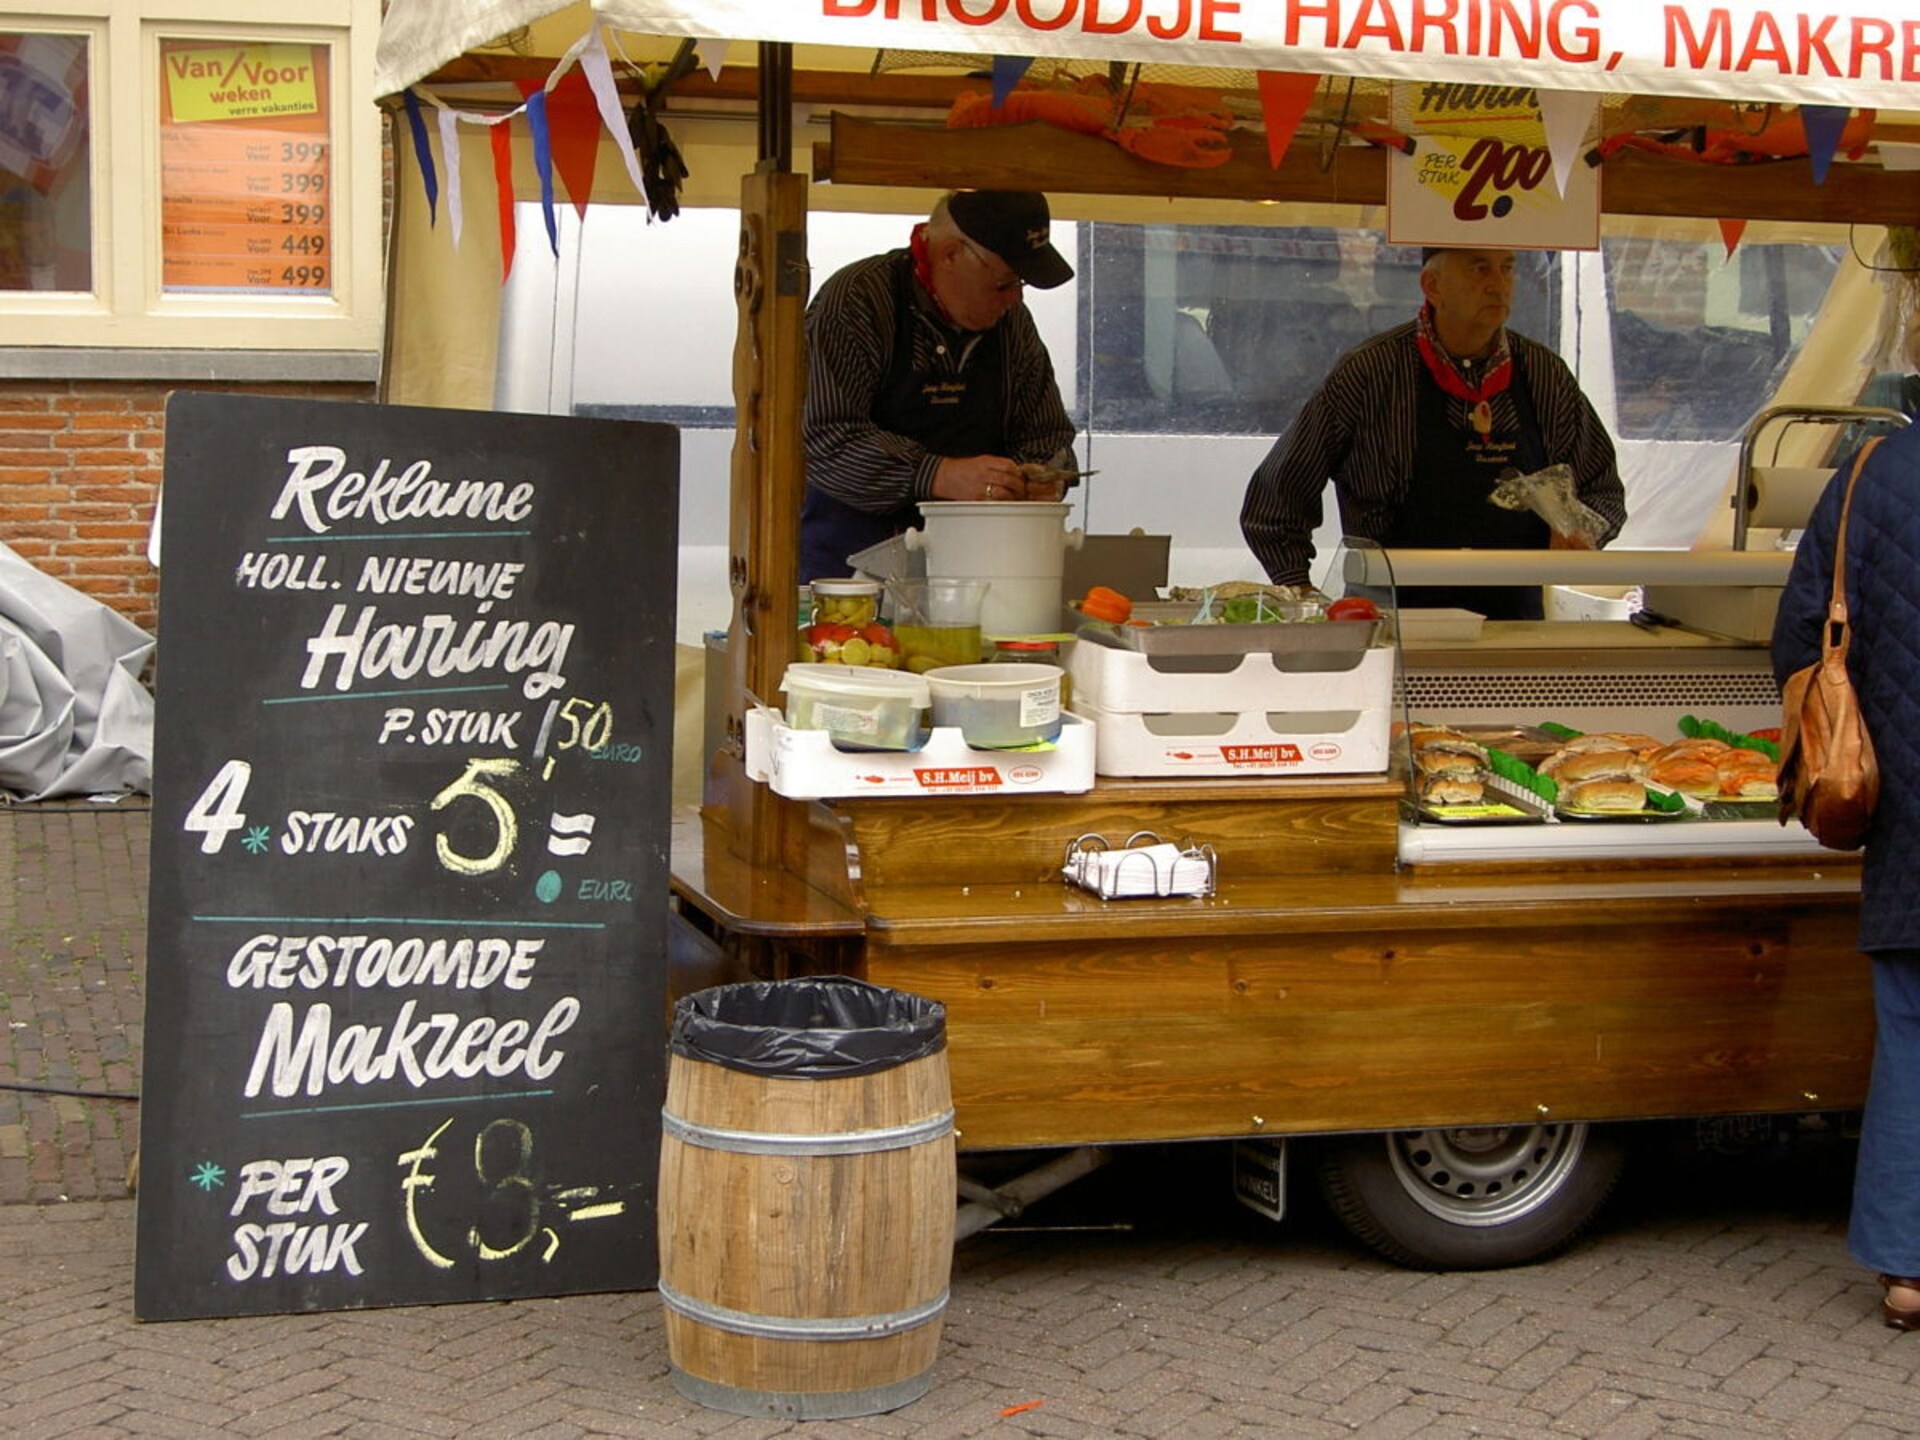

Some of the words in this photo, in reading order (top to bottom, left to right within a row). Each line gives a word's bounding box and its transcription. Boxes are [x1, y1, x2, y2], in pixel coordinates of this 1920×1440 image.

[1284, 0, 1624, 71] HARING,
[170, 52, 309, 88] Van/Voor
[210, 85, 272, 103] weken
[229, 106, 258, 115] verre
[262, 102, 315, 113] vakanties
[281, 142, 324, 163] 399
[1424, 153, 1457, 169] PER
[281, 174, 324, 193] 399
[1418, 169, 1461, 185] STUK
[281, 204, 325, 225] 399
[281, 235, 325, 255] 449
[281, 266, 325, 286] 499
[270, 446, 535, 533] Reklame
[235, 553, 341, 590] HOLL.
[357, 557, 526, 599] NIEUWE
[301, 600, 577, 700] Haring
[1281, 748, 1295, 759] bv
[979, 771, 994, 782] bv
[281, 811, 415, 857] STUKS
[227, 934, 544, 991] GESTOOMDE
[244, 996, 581, 1099] Makreel
[230, 1156, 350, 1219] PER
[227, 1222, 369, 1281] STUK
